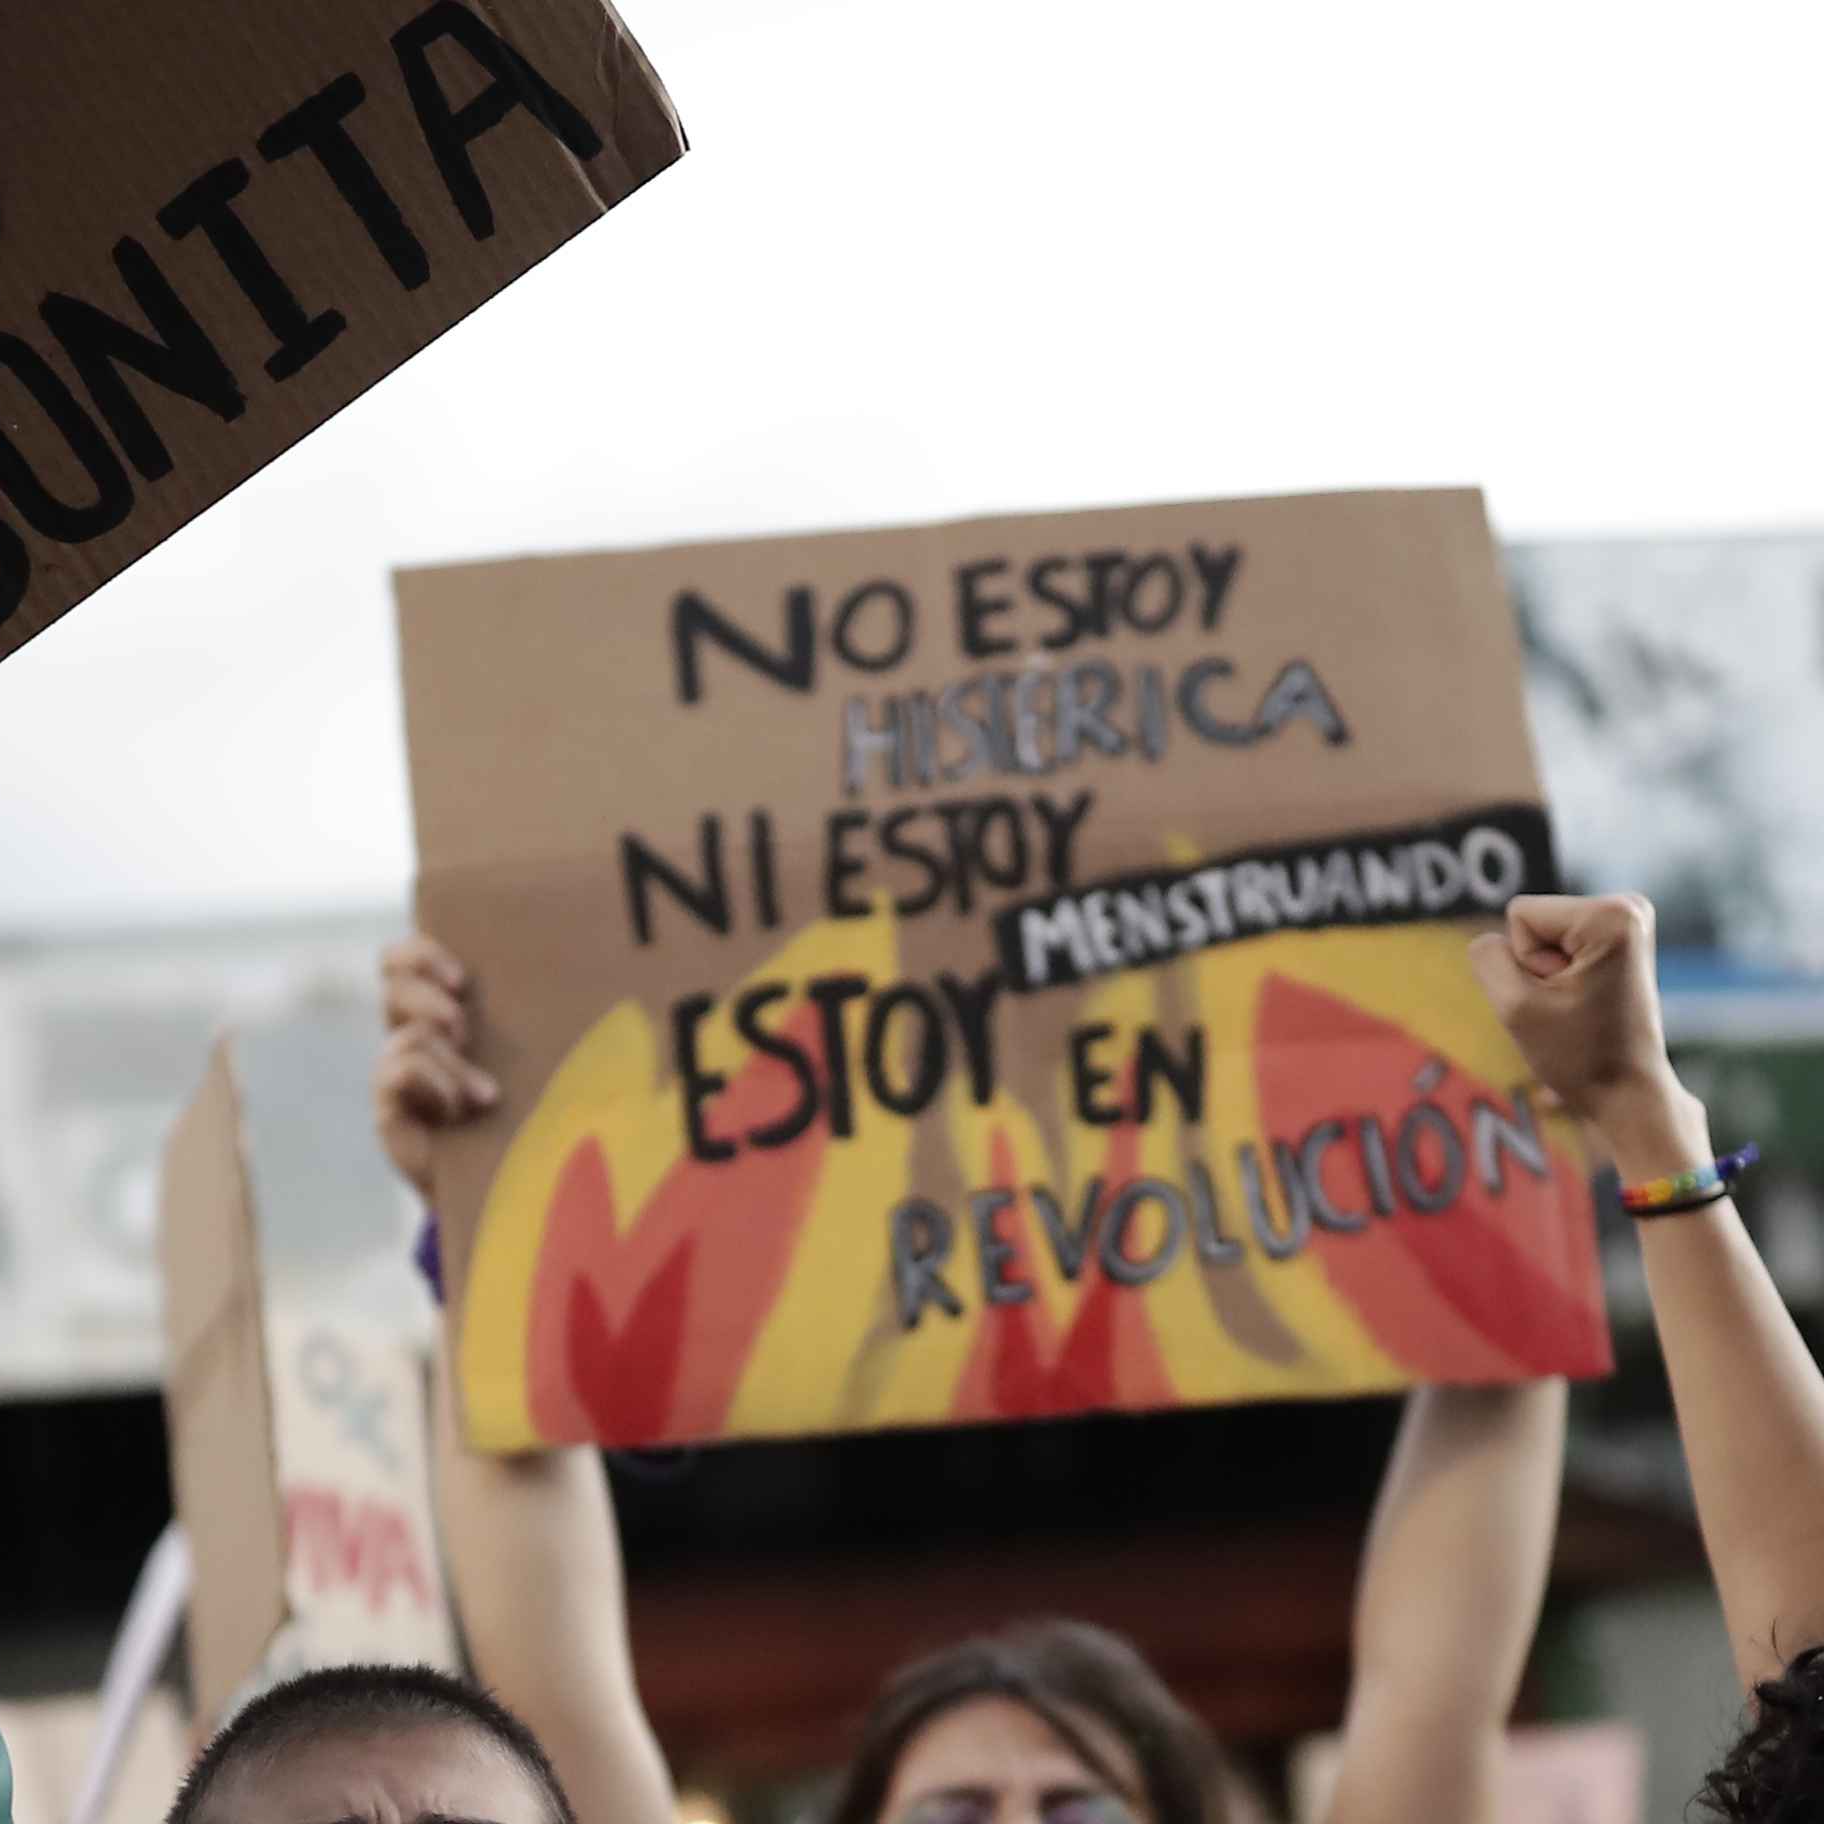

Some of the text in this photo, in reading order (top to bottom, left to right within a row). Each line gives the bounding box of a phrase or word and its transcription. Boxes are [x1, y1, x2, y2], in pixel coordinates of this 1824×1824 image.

[670, 542, 1248, 707] NO ESTOY
[616, 790, 1096, 947] NI ESTOY
[1016, 824, 1526, 990] MENSTRUANDO
[670, 965, 1210, 1166] ESTOY EN
[888, 1060, 1554, 1335] REVOLUCIÓN
